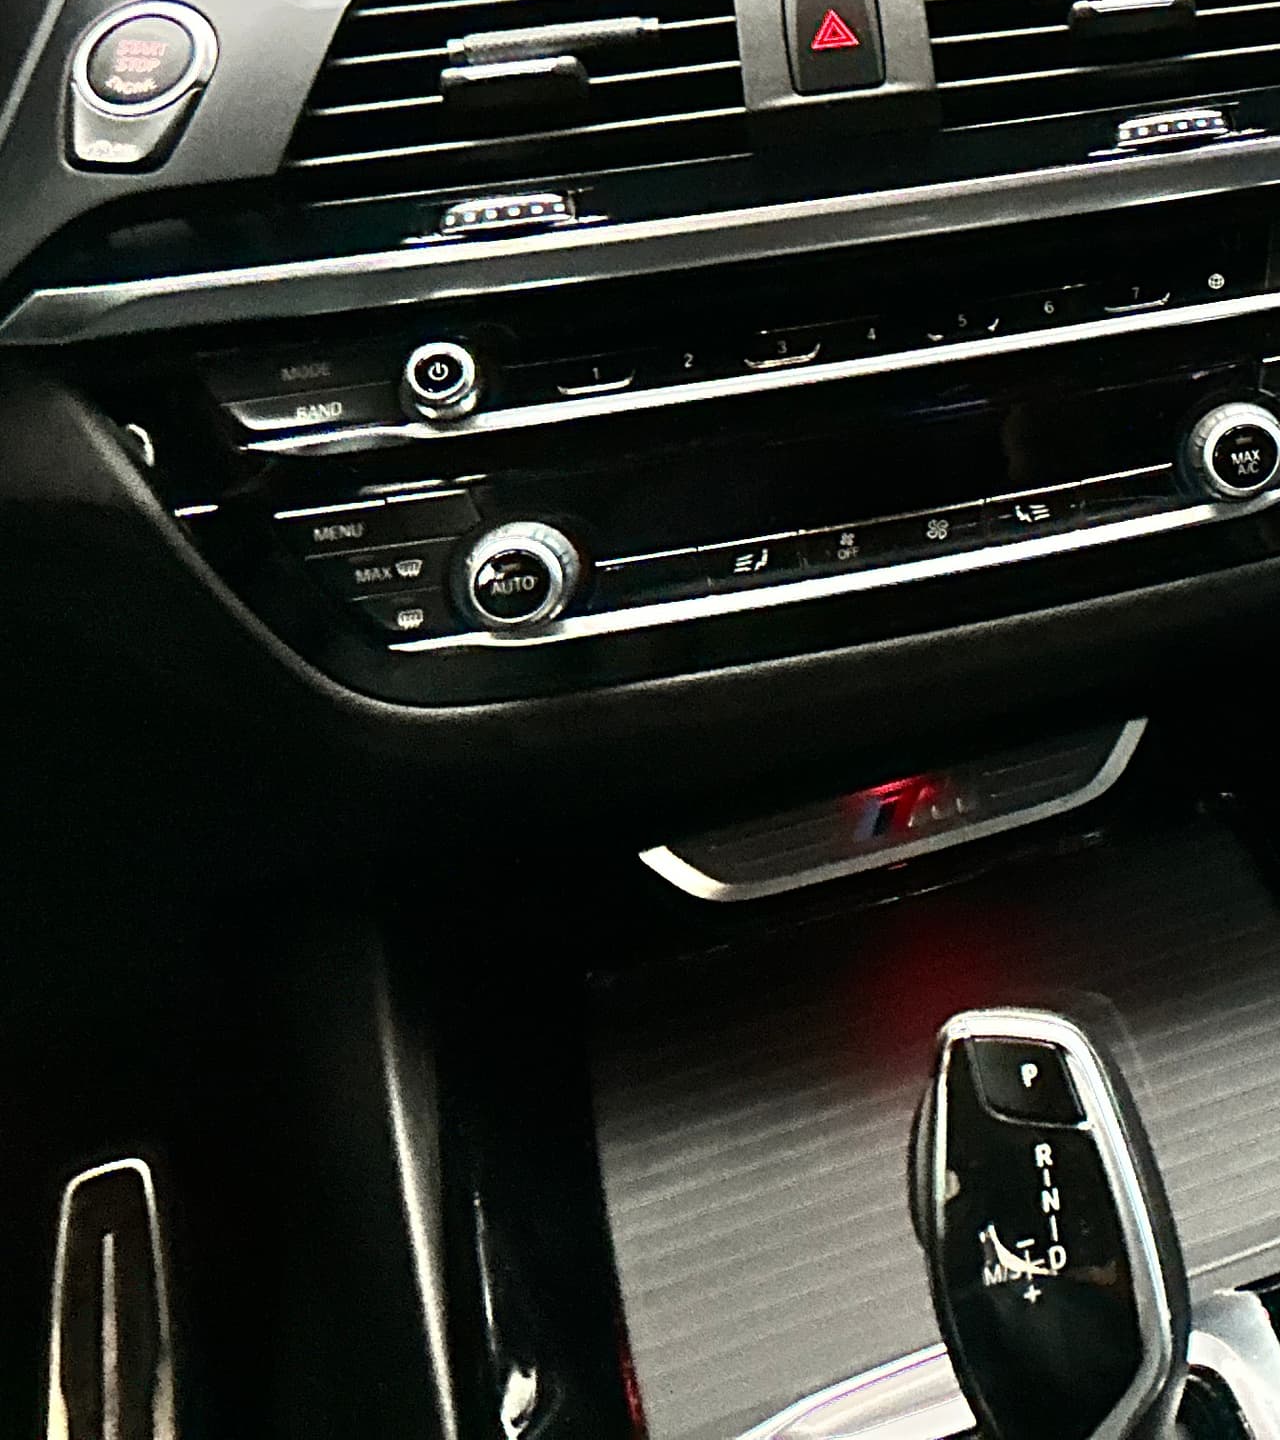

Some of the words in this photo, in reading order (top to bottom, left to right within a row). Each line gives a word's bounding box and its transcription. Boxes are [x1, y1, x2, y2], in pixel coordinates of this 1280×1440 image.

[115, 56, 160, 72] STOP
[1131, 286, 1141, 300] 7
[1043, 300, 1054, 314] 6
[957, 313, 968, 328] 5
[866, 327, 877, 340] 4
[776, 340, 788, 354] 3
[683, 352, 694, 368] 2
[592, 367, 600, 380] 1
[296, 401, 342, 422] BAND
[1231, 449, 1260, 465] MAX
[1237, 461, 1260, 476] A/C
[313, 522, 365, 543] MENU
[837, 546, 860, 561] OFF
[355, 568, 393, 584] MAX
[491, 575, 536, 596] AUTO
[1020, 1062, 1039, 1088] P
[1034, 1143, 1053, 1168] R
[1041, 1187, 1061, 1211] N
[1048, 1245, 1067, 1271] D
